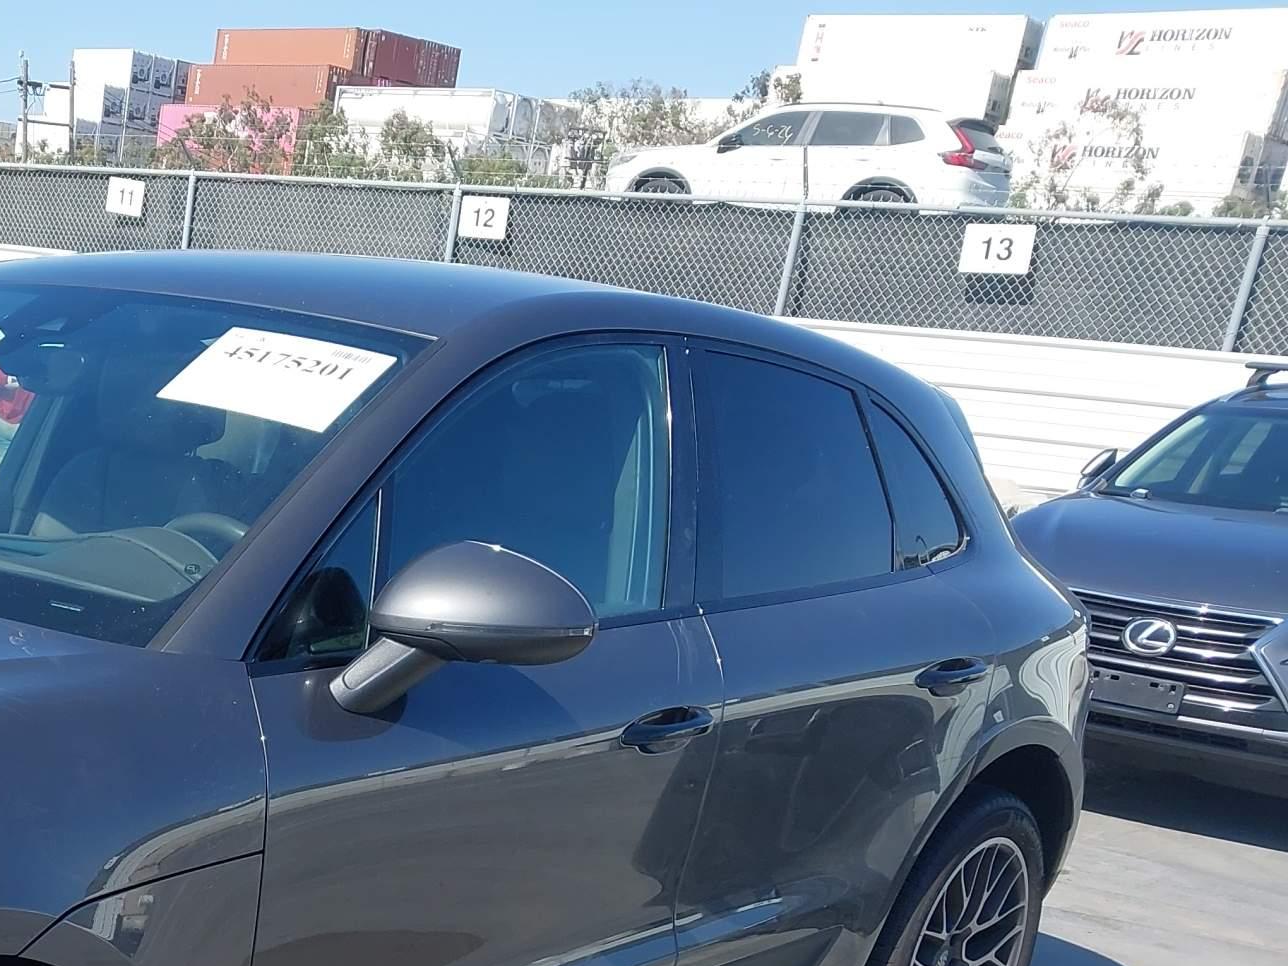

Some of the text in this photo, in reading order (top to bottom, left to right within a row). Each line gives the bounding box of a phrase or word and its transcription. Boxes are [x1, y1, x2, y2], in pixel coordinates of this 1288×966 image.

[1149, 27, 1233, 42] HORIZON
[1115, 87, 1196, 100] HORIZON
[1081, 145, 1161, 160] HORIZON
[119, 187, 133, 206] 11
[473, 207, 495, 228] 12
[981, 236, 1014, 261] 13
[223, 345, 355, 381] 45175201
